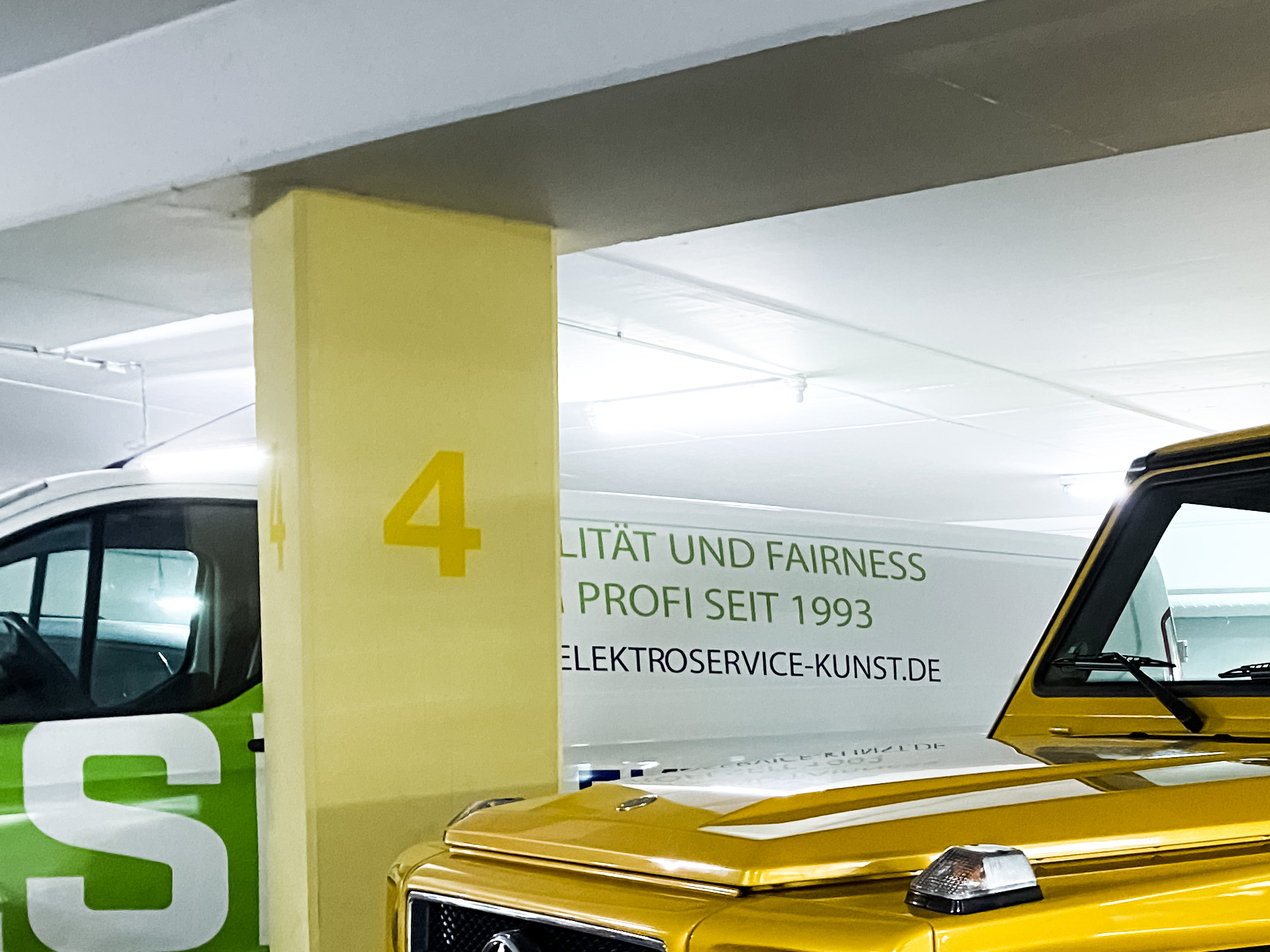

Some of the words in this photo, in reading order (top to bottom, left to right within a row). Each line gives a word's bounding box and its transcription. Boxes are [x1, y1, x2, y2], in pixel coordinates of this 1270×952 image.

[382, 450, 481, 577] 4
[669, 533, 755, 569] UND
[766, 541, 927, 582] FAIRNESS
[578, 581, 693, 619] PROFI
[704, 588, 779, 623] SEIT
[791, 595, 873, 629] 1993
